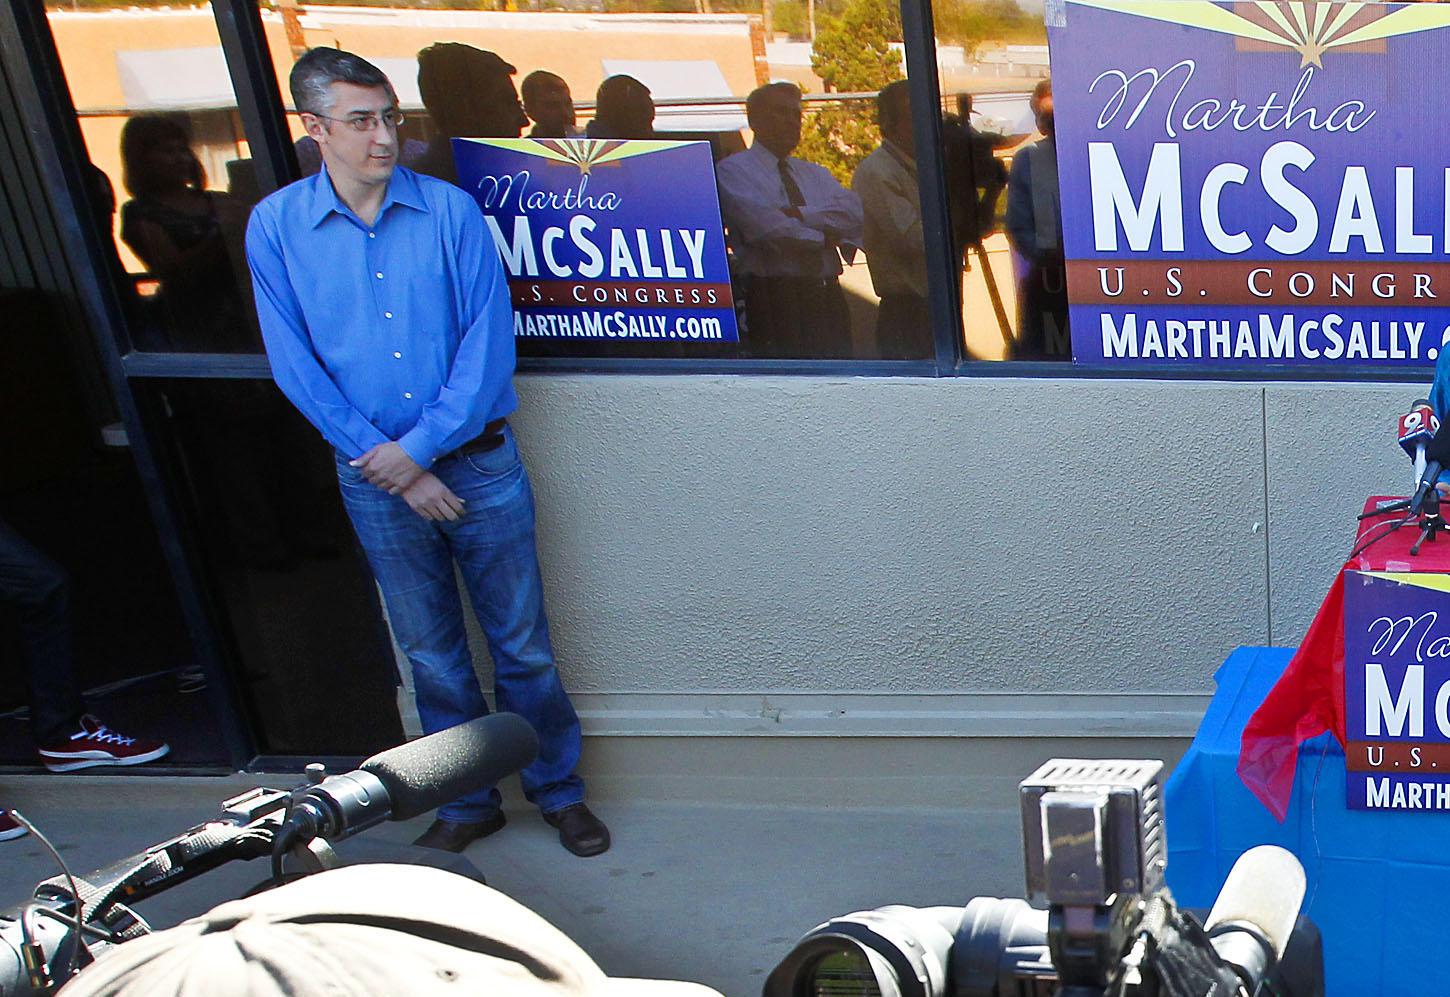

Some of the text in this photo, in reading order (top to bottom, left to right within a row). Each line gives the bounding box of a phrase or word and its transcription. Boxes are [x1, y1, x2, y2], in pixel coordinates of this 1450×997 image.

[1088, 59, 1376, 138] Martha
[478, 170, 622, 214] Martha
[520, 285, 719, 304] .S. CONGRESS
[1097, 267, 1207, 298] U.S.
[1404, 411, 1423, 436] 9
[1366, 746, 1438, 768] U.S.
